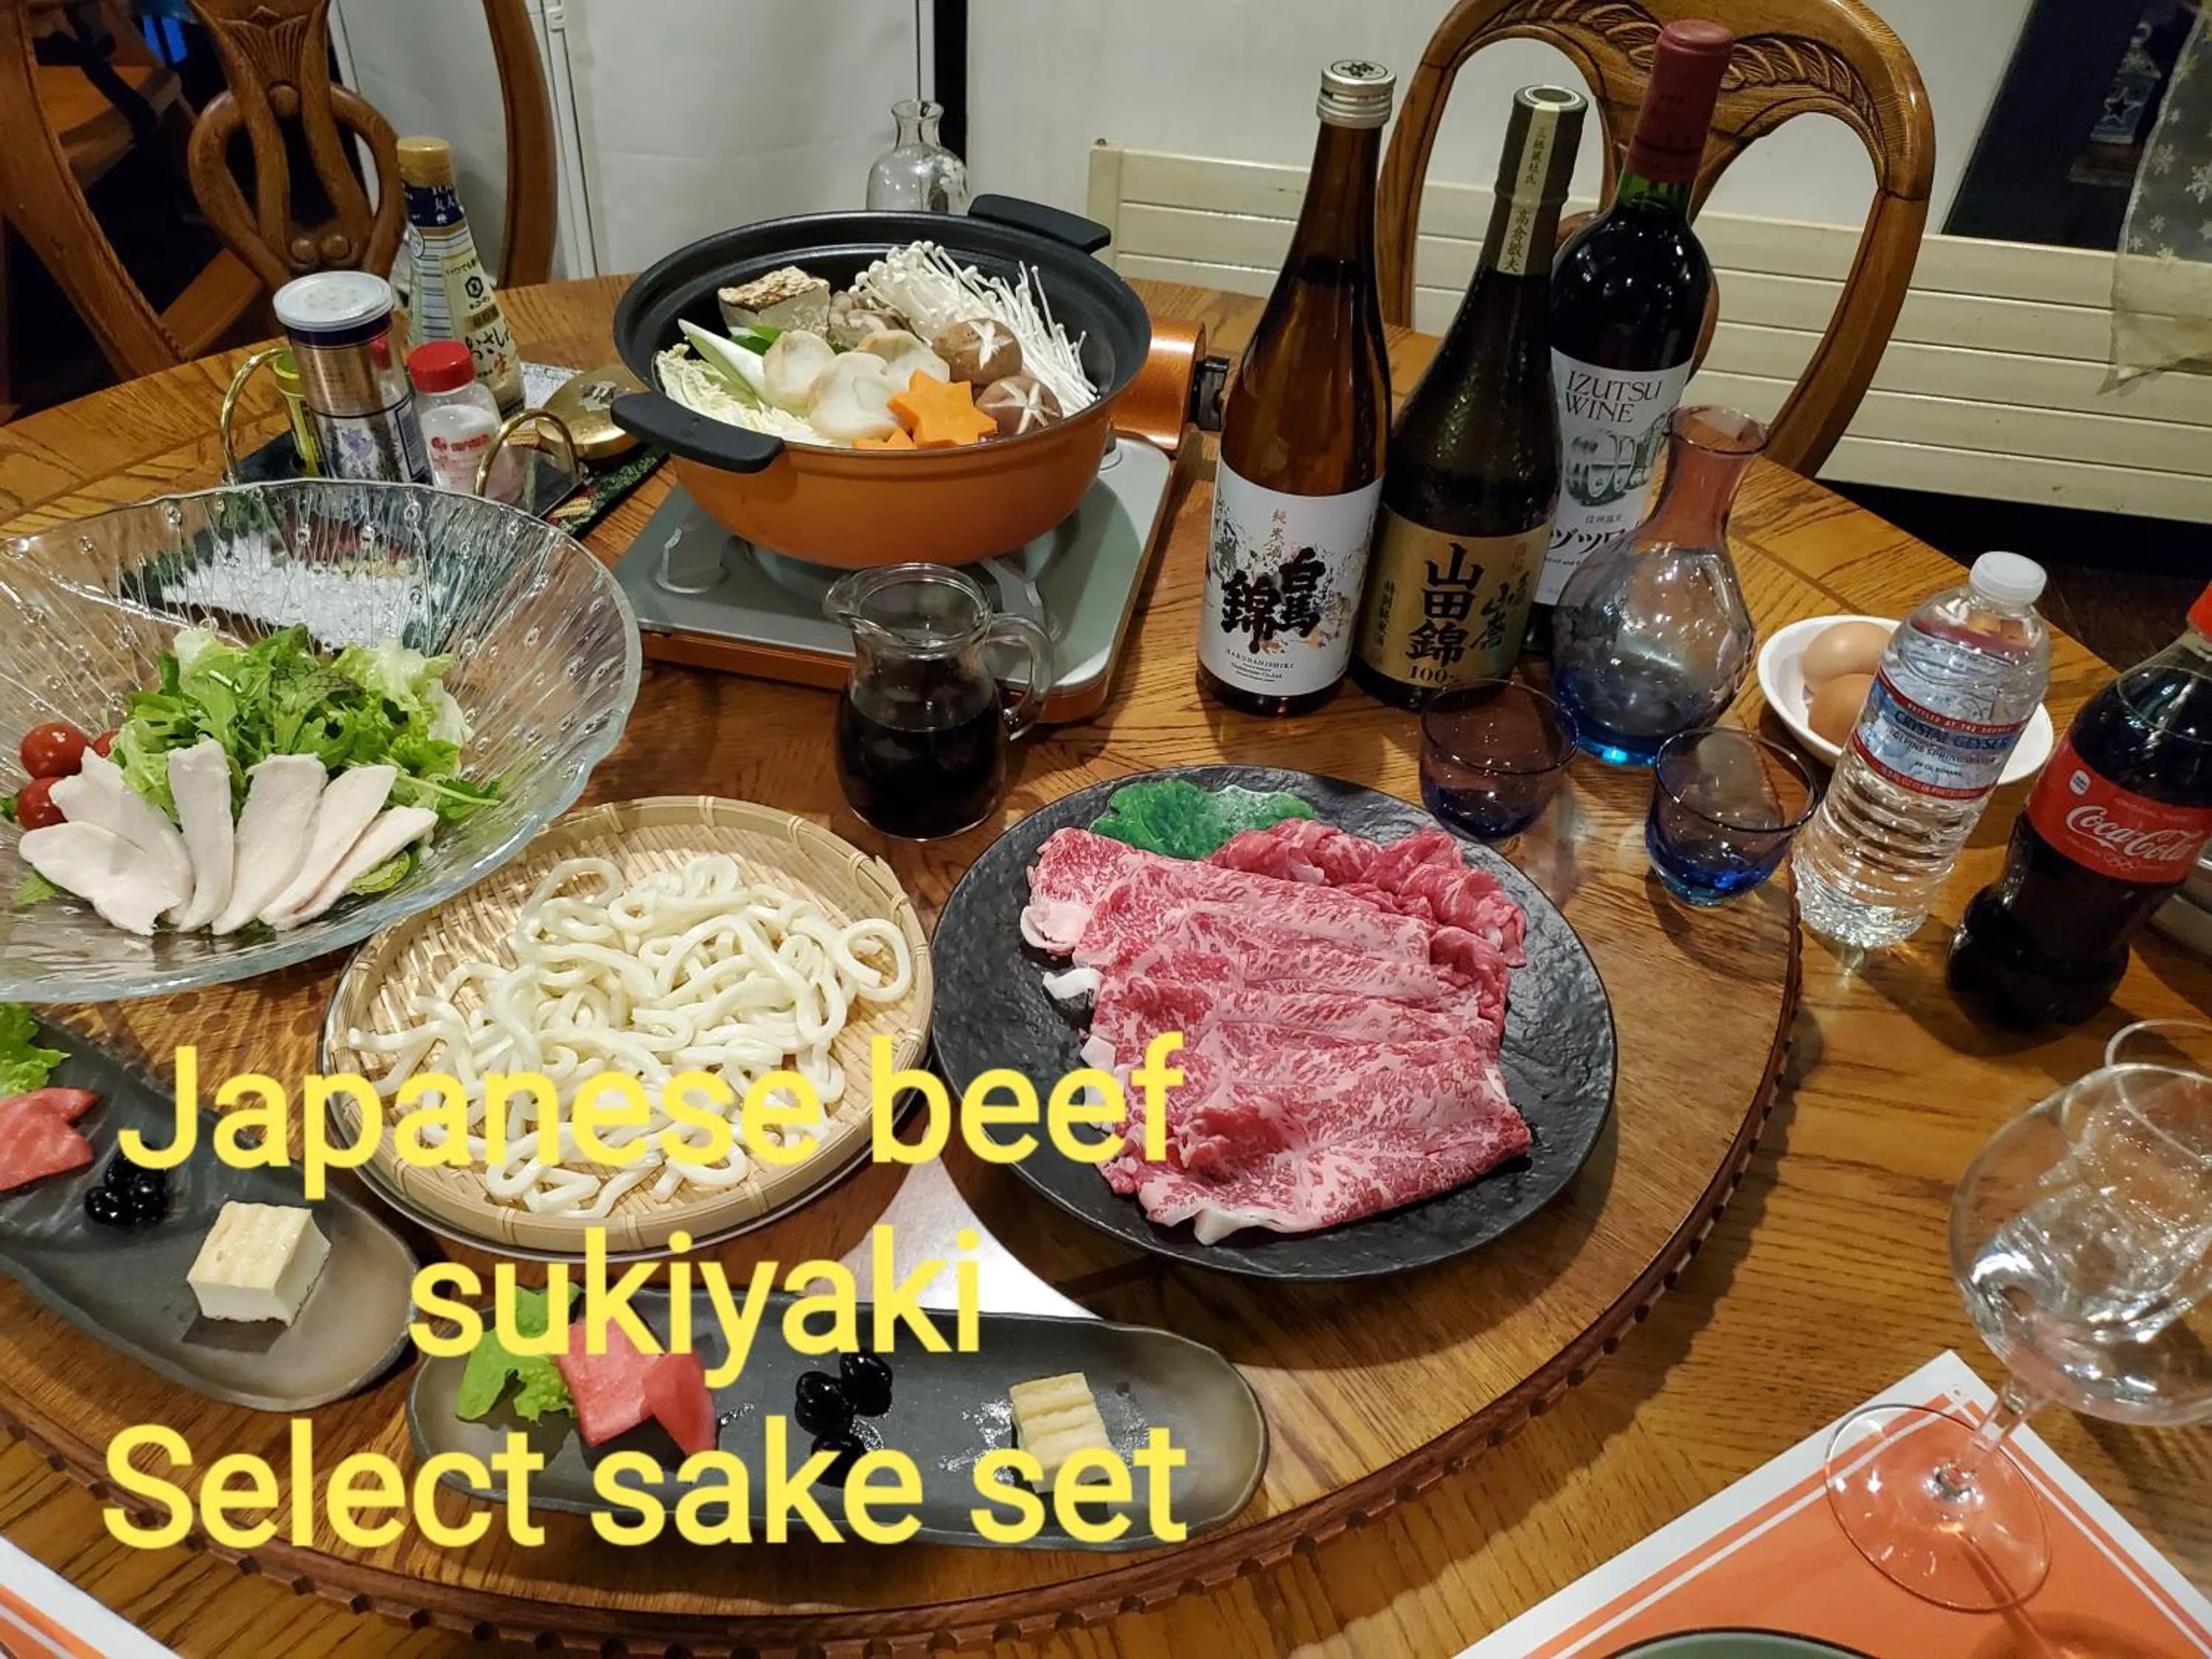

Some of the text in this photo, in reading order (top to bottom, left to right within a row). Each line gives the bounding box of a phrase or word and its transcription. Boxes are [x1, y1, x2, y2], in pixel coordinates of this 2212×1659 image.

[1567, 370, 1662, 402] IZUTSU
[1565, 392, 1635, 424] WINE
[1405, 541, 1485, 668] 山田錦
[1894, 709, 1950, 745] CRYSTAL
